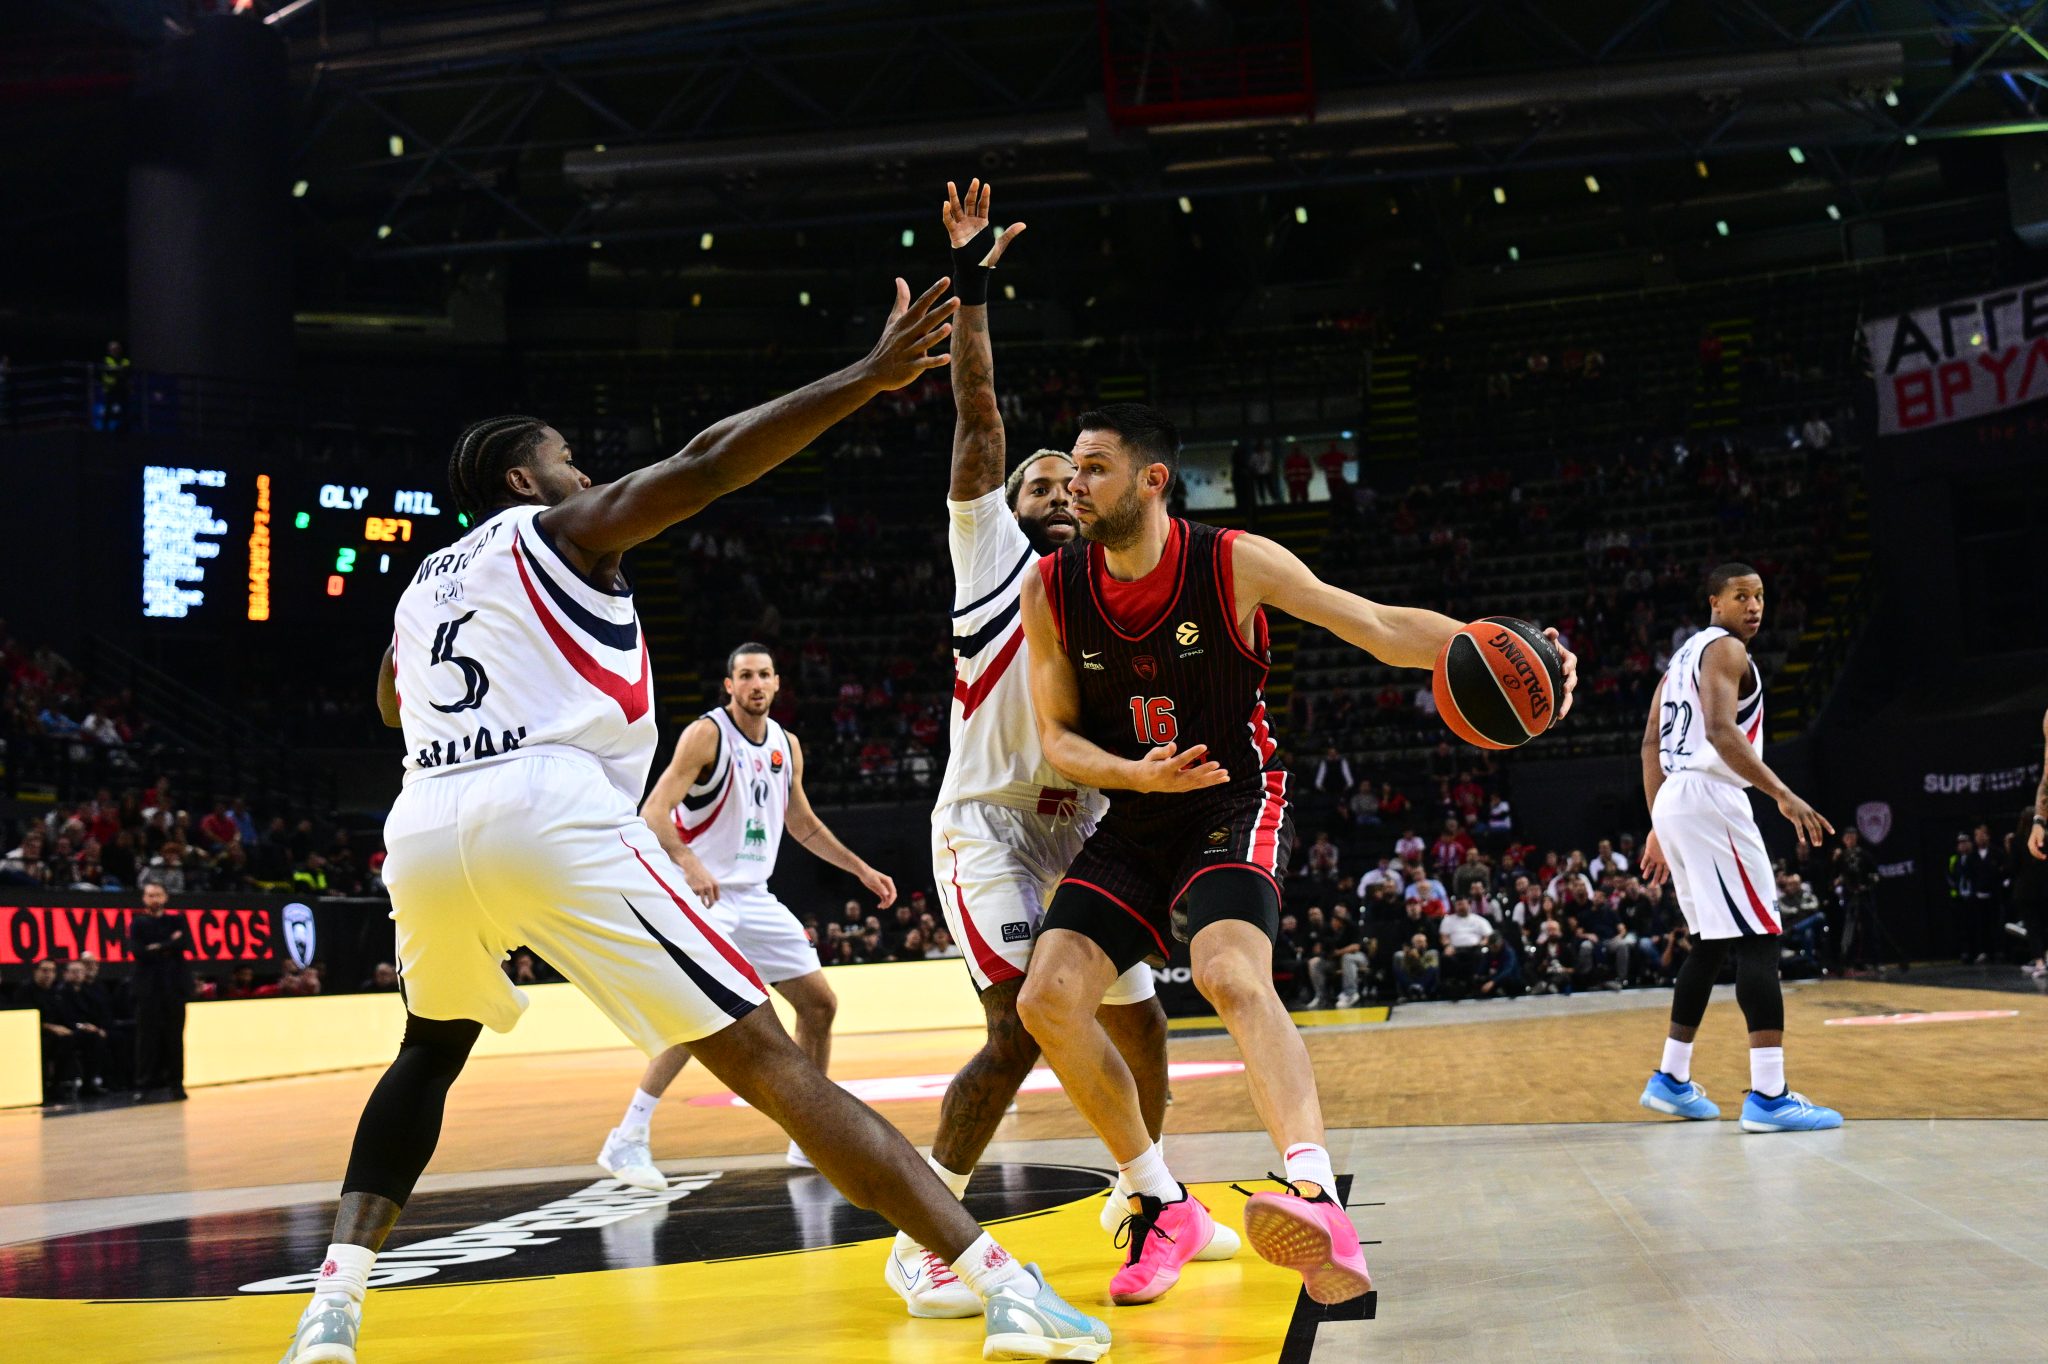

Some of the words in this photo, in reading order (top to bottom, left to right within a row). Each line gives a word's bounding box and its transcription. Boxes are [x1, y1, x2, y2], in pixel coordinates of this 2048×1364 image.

[319, 484, 369, 510] OLY
[394, 490, 441, 516] MIL
[336, 547, 356, 573] 2
[428, 609, 490, 714] 5
[1488, 631, 1549, 720] SPALDING
[1130, 695, 1178, 745] 16
[11, 907, 272, 962] OLYMCOS
[1003, 923, 1027, 935] EA7
